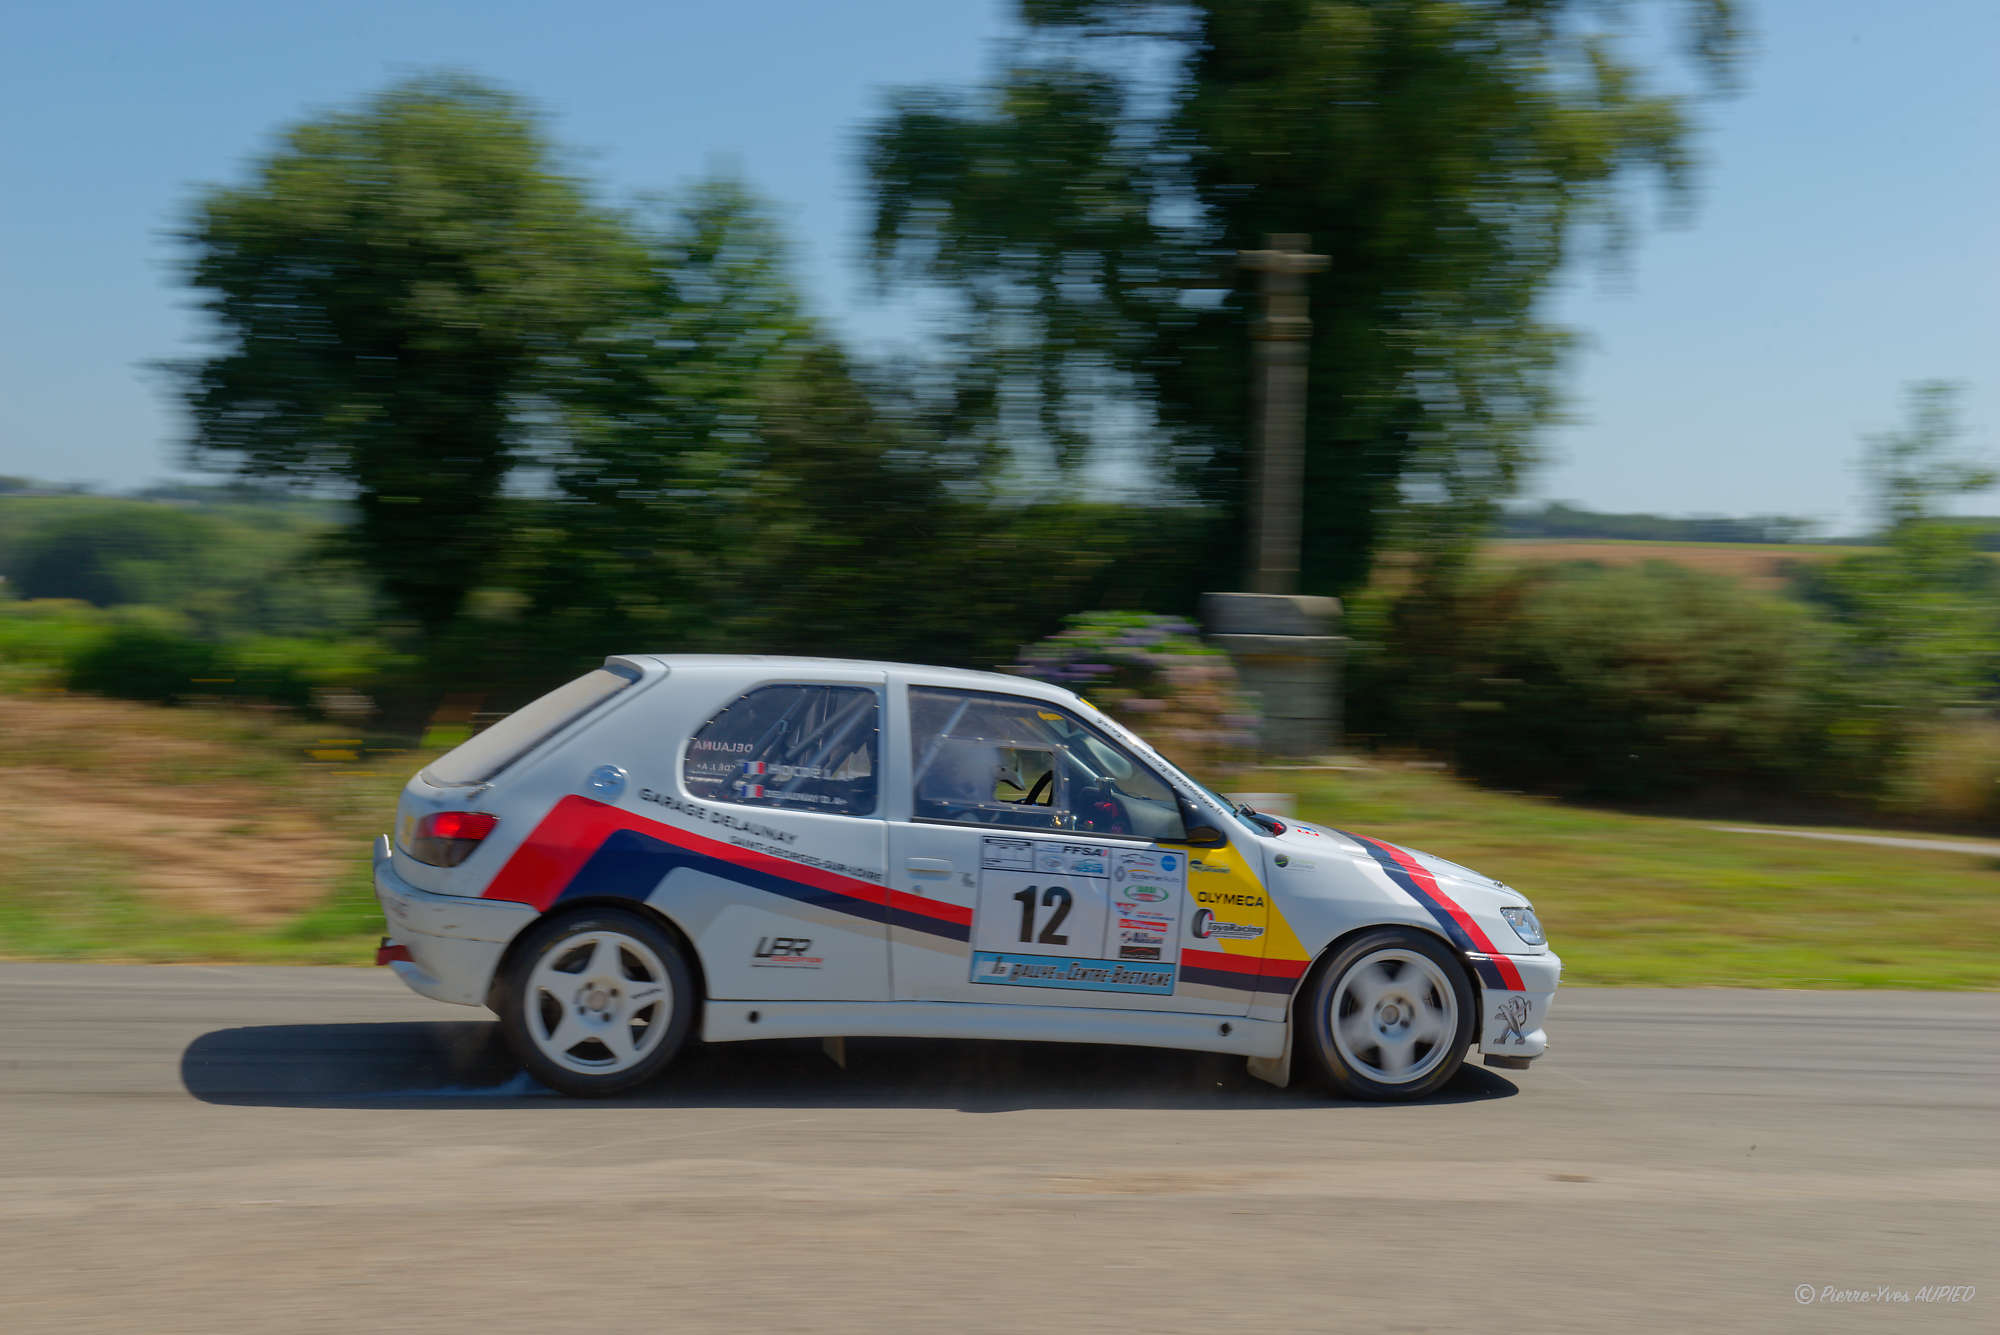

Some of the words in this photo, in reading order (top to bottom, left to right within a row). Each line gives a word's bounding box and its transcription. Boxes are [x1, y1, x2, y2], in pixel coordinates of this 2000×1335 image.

[640, 787, 707, 821] GARAGE
[709, 811, 798, 845] DELAUNAY
[1062, 845, 1103, 857] FFSA
[1013, 885, 1074, 945] 12
[1197, 890, 1265, 908] OLYMECA
